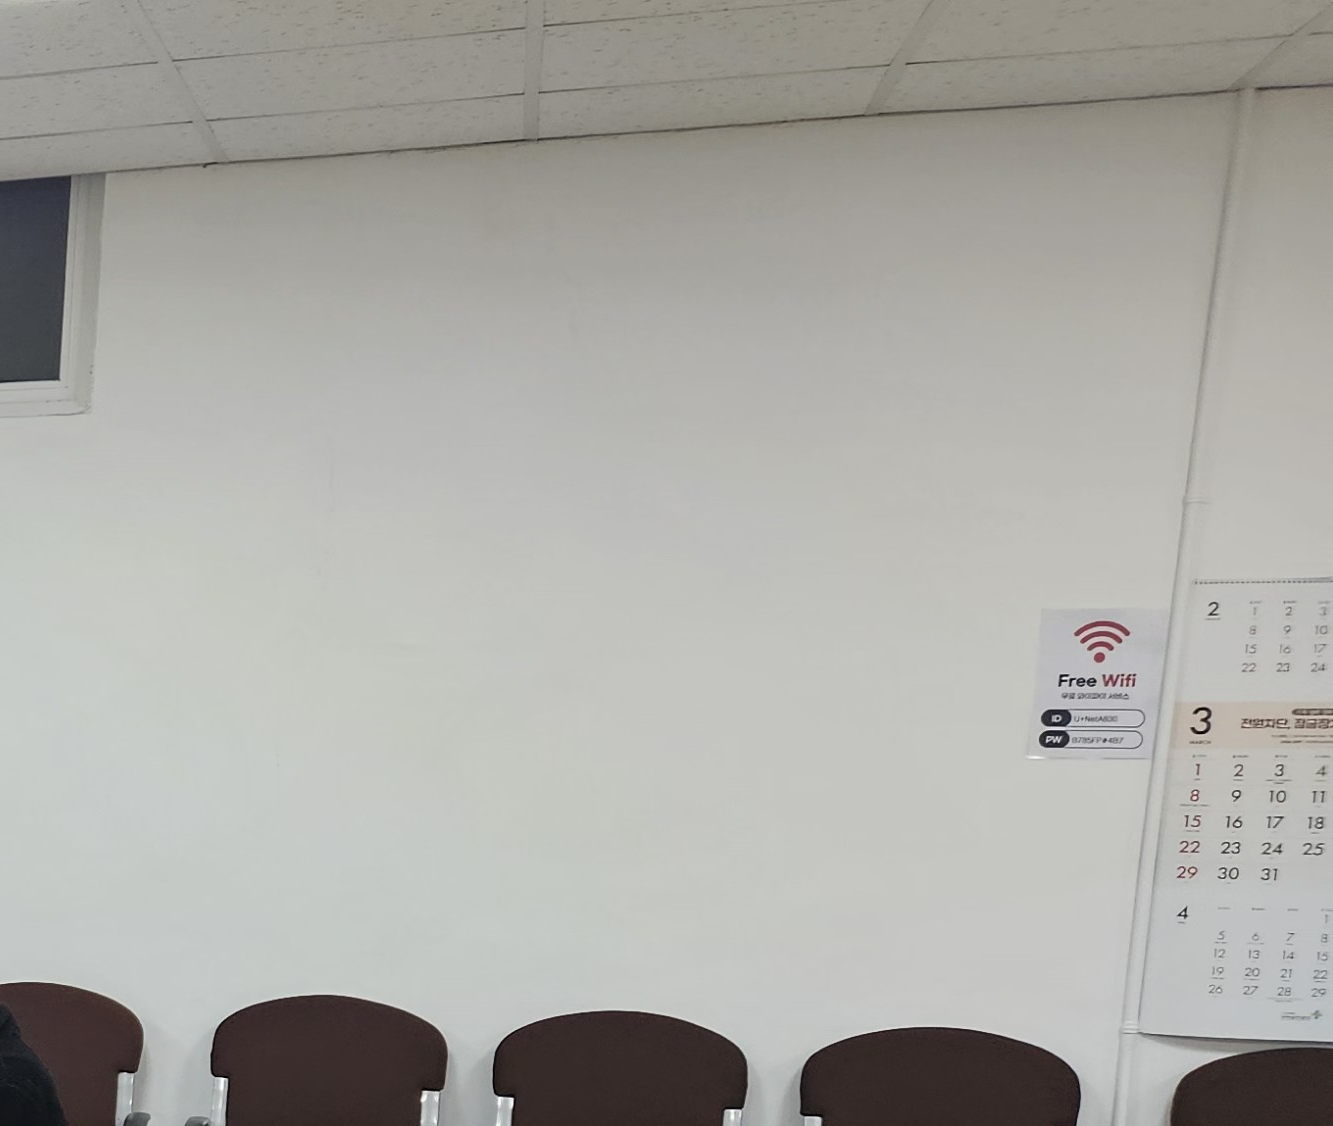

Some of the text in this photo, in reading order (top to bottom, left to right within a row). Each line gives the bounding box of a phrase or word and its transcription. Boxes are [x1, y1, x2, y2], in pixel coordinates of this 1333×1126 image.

[1207, 601, 1220, 616] 2
[1252, 607, 1257, 616] 1
[1285, 606, 1293, 616] 2
[1249, 625, 1328, 635] 8 9 10
[1245, 643, 1327, 654] 15 16 17
[1242, 662, 1326, 673] 22 23 24
[1058, 673, 1137, 688] Free Wifi
[1051, 714, 1062, 722] ID
[1189, 706, 1213, 735] 3
[1294, 718, 1333, 729] 잠금장
[1045, 735, 1064, 743] PW
[1195, 763, 1327, 777] 1 2 3 4
[1190, 789, 1326, 803] 8 9 10 11
[1184, 815, 1325, 830] 15 16 17 18
[1179, 840, 1325, 856] 22 23 24 25
[1176, 866, 1278, 881] 29 30 31
[1176, 905, 1189, 919] 4
[1217, 930, 1328, 943] 5 6 7 8
[1213, 948, 1225, 958] 12
[1248, 950, 1260, 959] 13
[1282, 950, 1294, 960] 14
[1211, 966, 1328, 979] 19 20 21 22
[1208, 984, 1327, 998] 26 27 28 29
